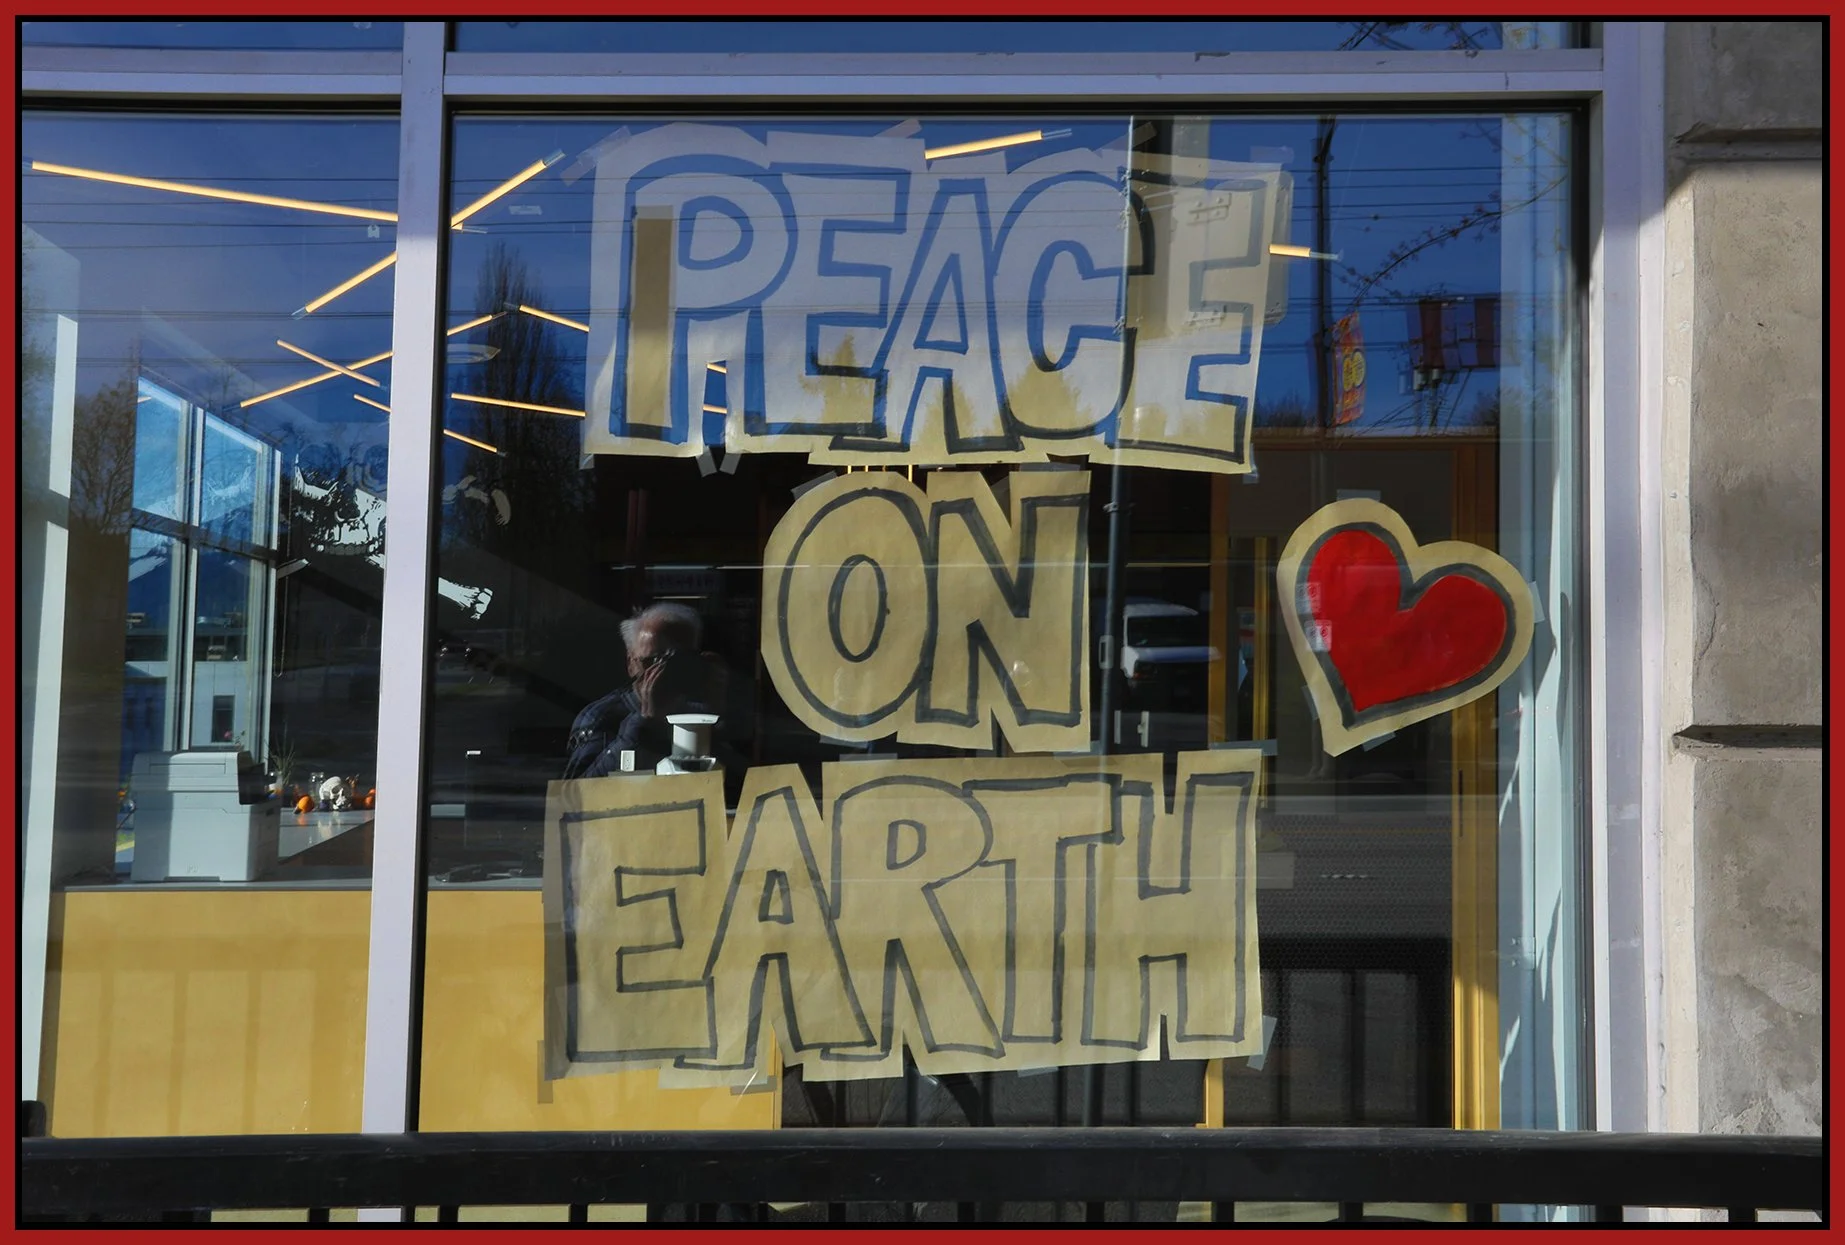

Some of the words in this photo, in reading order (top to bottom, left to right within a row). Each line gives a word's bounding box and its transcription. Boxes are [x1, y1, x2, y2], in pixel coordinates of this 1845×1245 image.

[609, 154, 1266, 463] PEACE
[778, 487, 1088, 727] ON
[559, 771, 1256, 1071] EARTH
